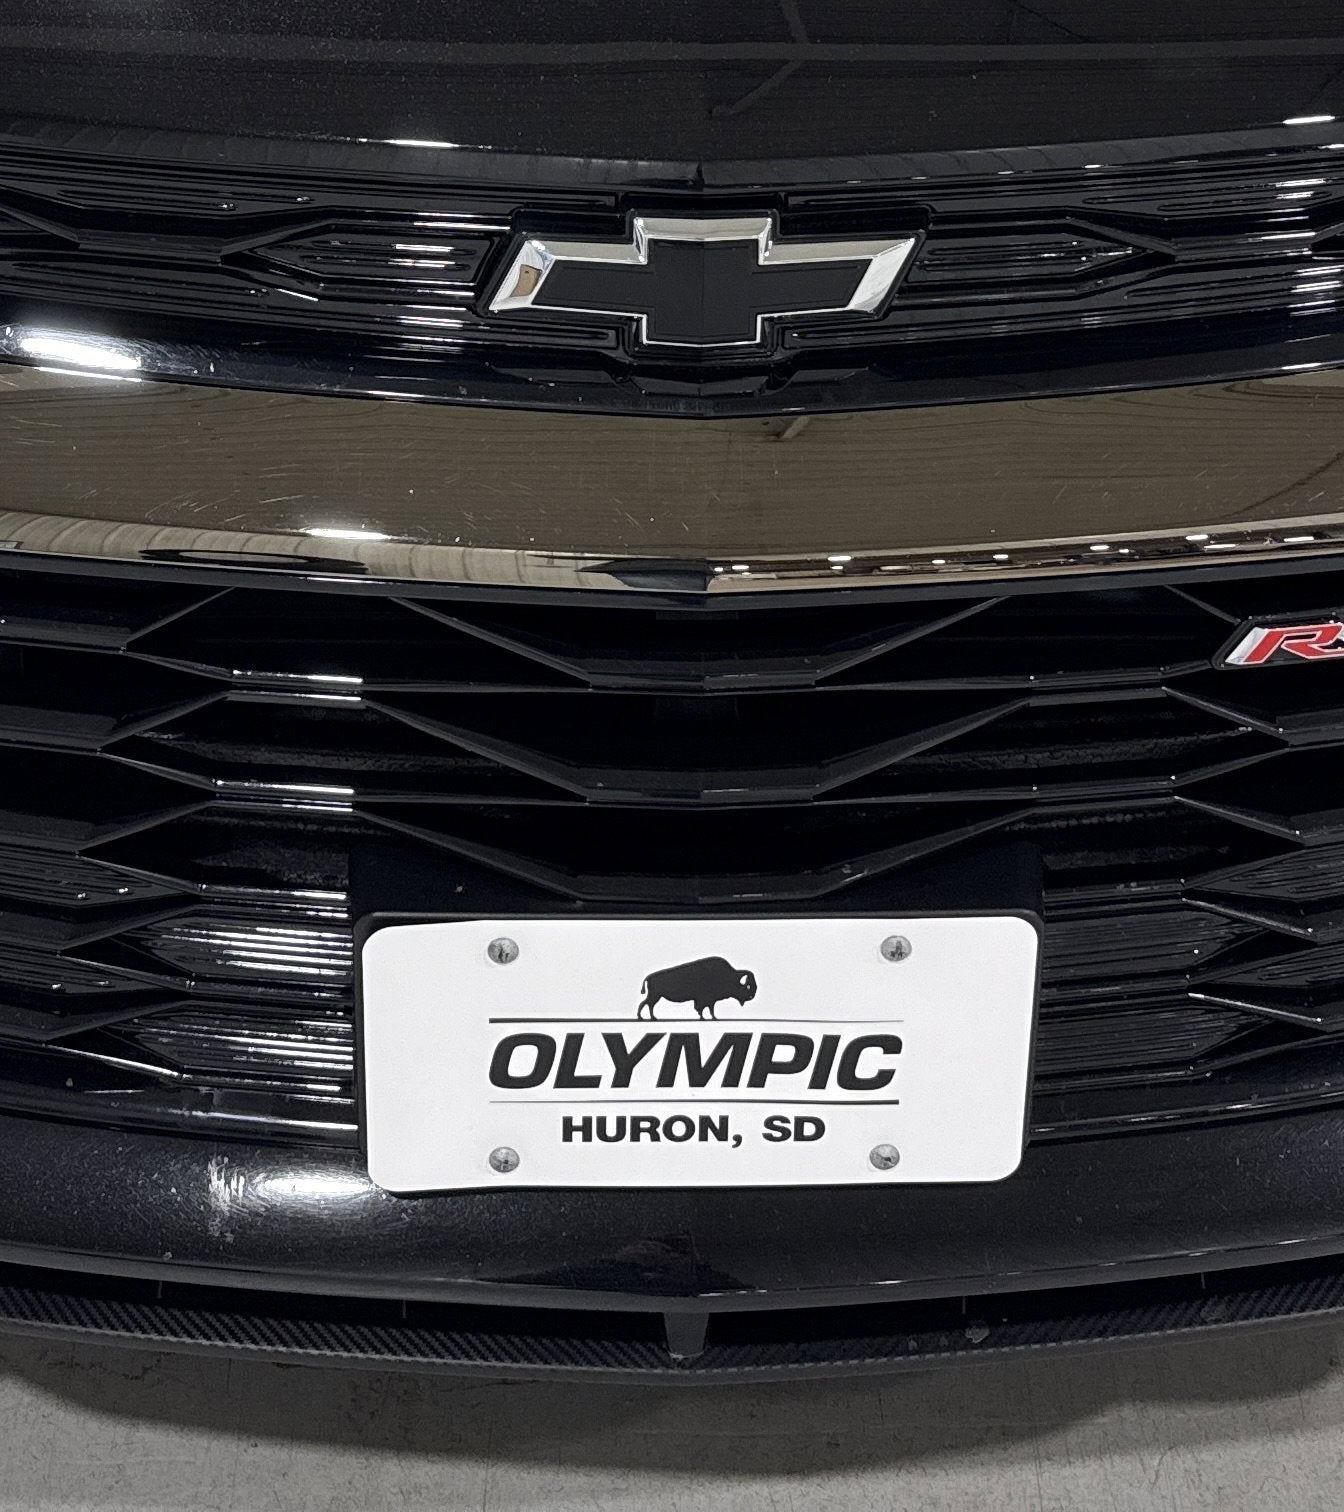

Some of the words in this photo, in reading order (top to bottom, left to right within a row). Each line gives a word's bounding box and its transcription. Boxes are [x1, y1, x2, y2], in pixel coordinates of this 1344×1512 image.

[488, 1032, 903, 1091] OLYMPIC
[561, 1114, 744, 1149] HURON,
[762, 1114, 827, 1143] SD
